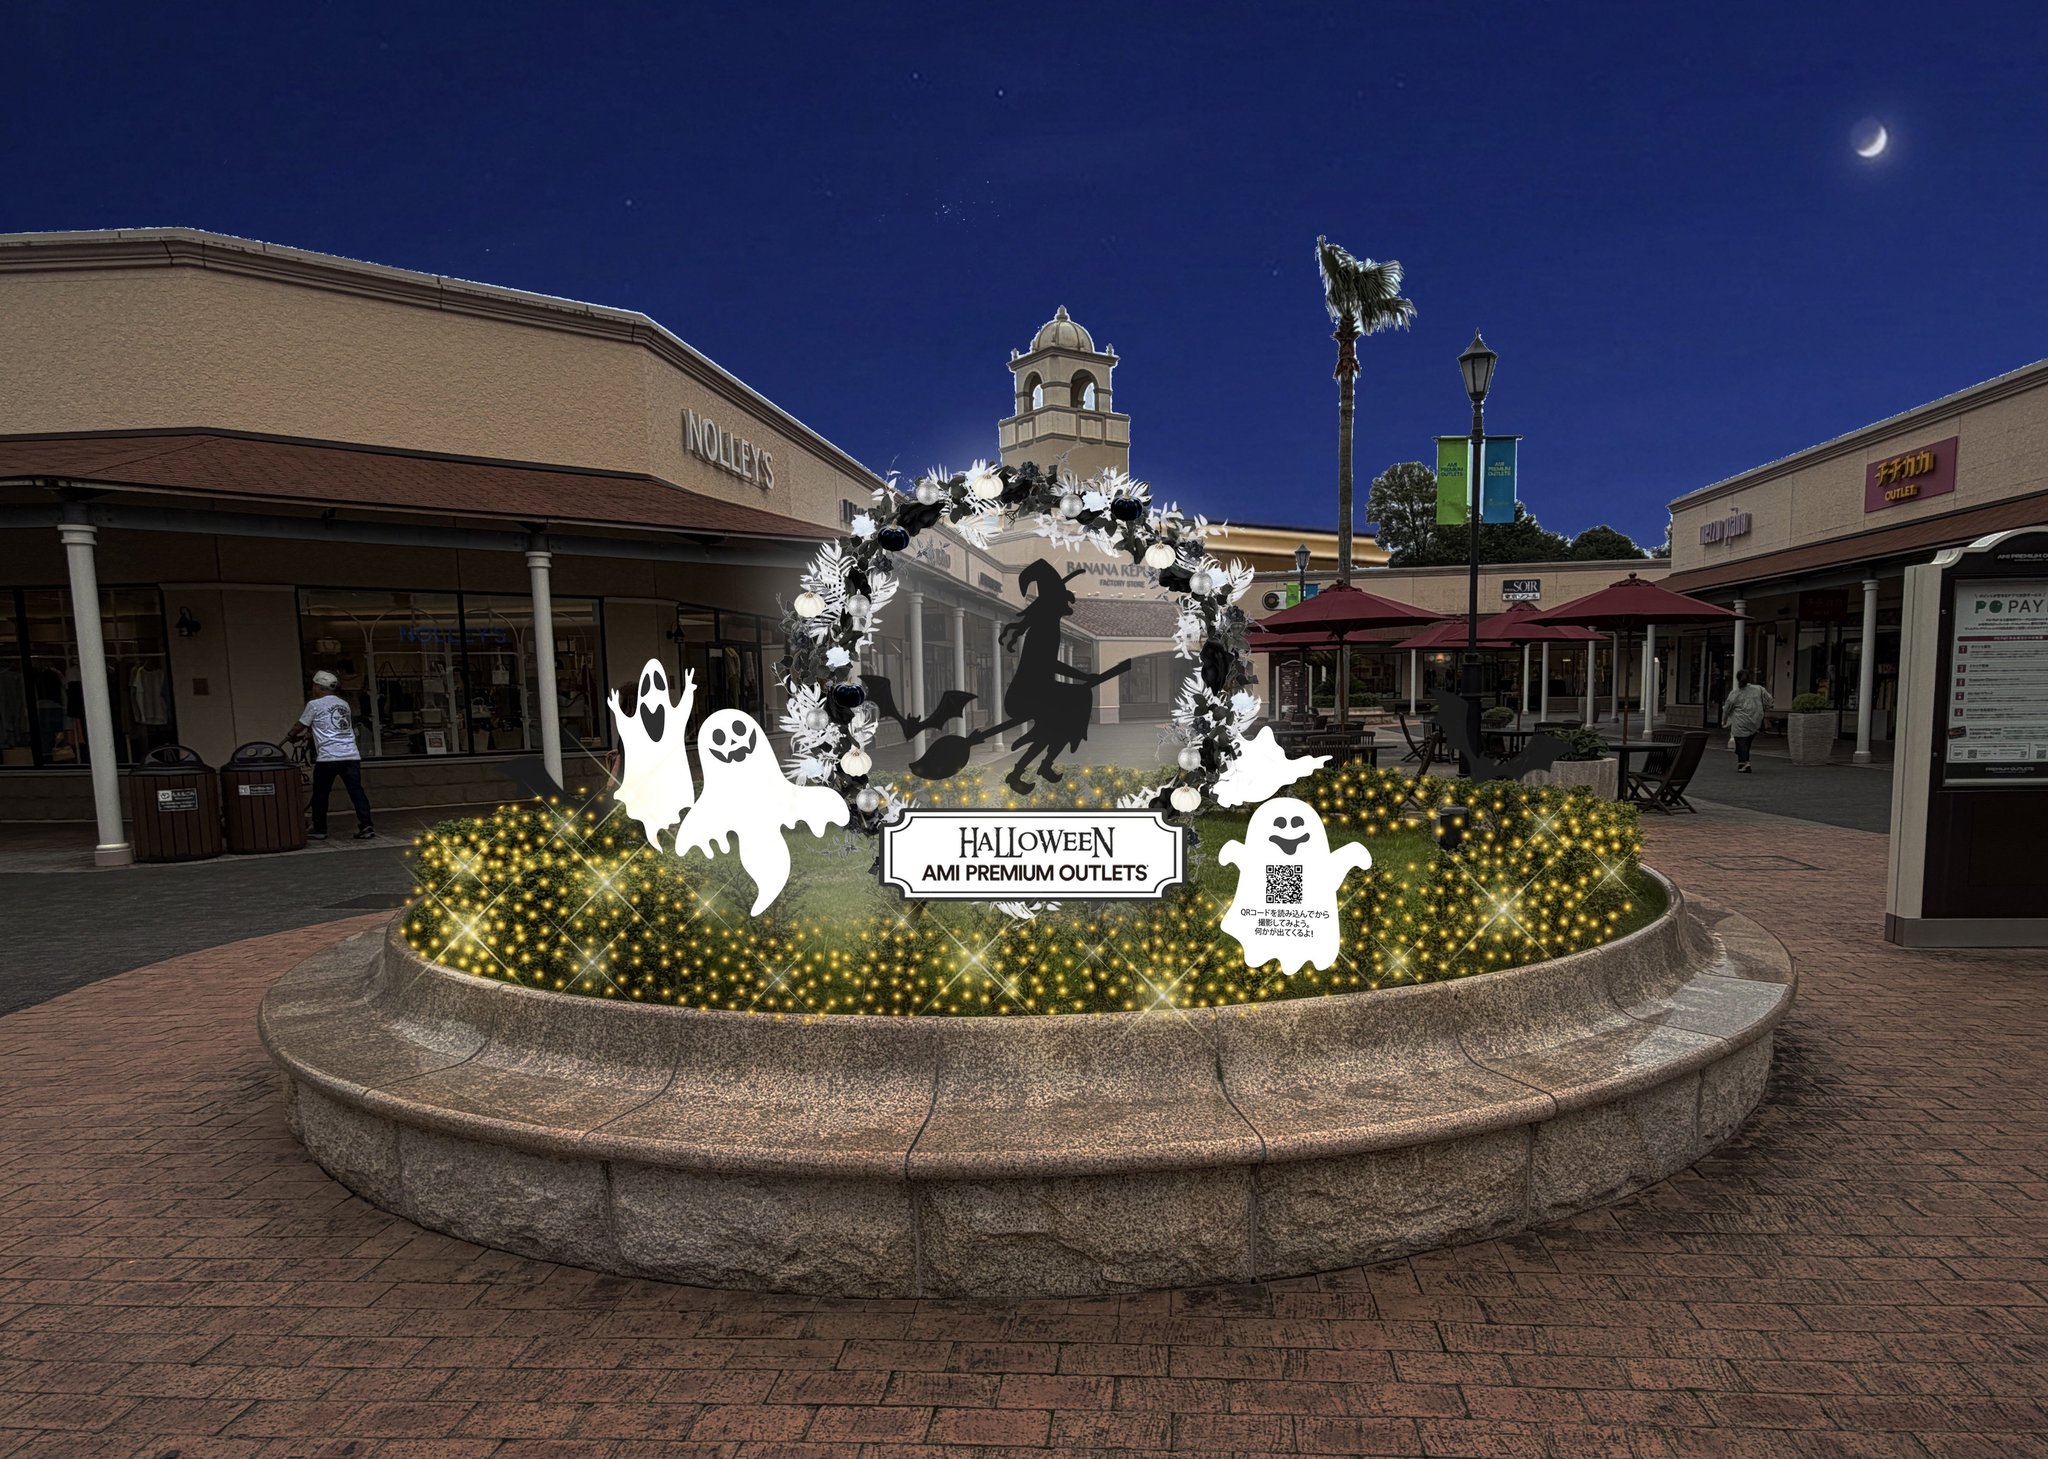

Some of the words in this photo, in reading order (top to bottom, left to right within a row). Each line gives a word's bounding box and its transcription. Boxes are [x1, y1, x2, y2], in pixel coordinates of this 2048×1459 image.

[683, 408, 775, 489] NOLLEY'S
[1874, 450, 1934, 487] チチカカ
[1884, 484, 1918, 501] OUTLET
[1066, 561, 1119, 577] BANANA
[1513, 580, 1538, 592] SOIR
[2008, 600, 2043, 614] PAY
[958, 826, 1115, 859] HALLOWEEN
[921, 864, 960, 881] AMI
[966, 864, 1054, 881] PREMIUM
[1059, 864, 1148, 881] OUTLETS
[1240, 908, 1330, 919] QRコードを読み込んでから
[1258, 918, 1310, 929] 撮影してみよう。
